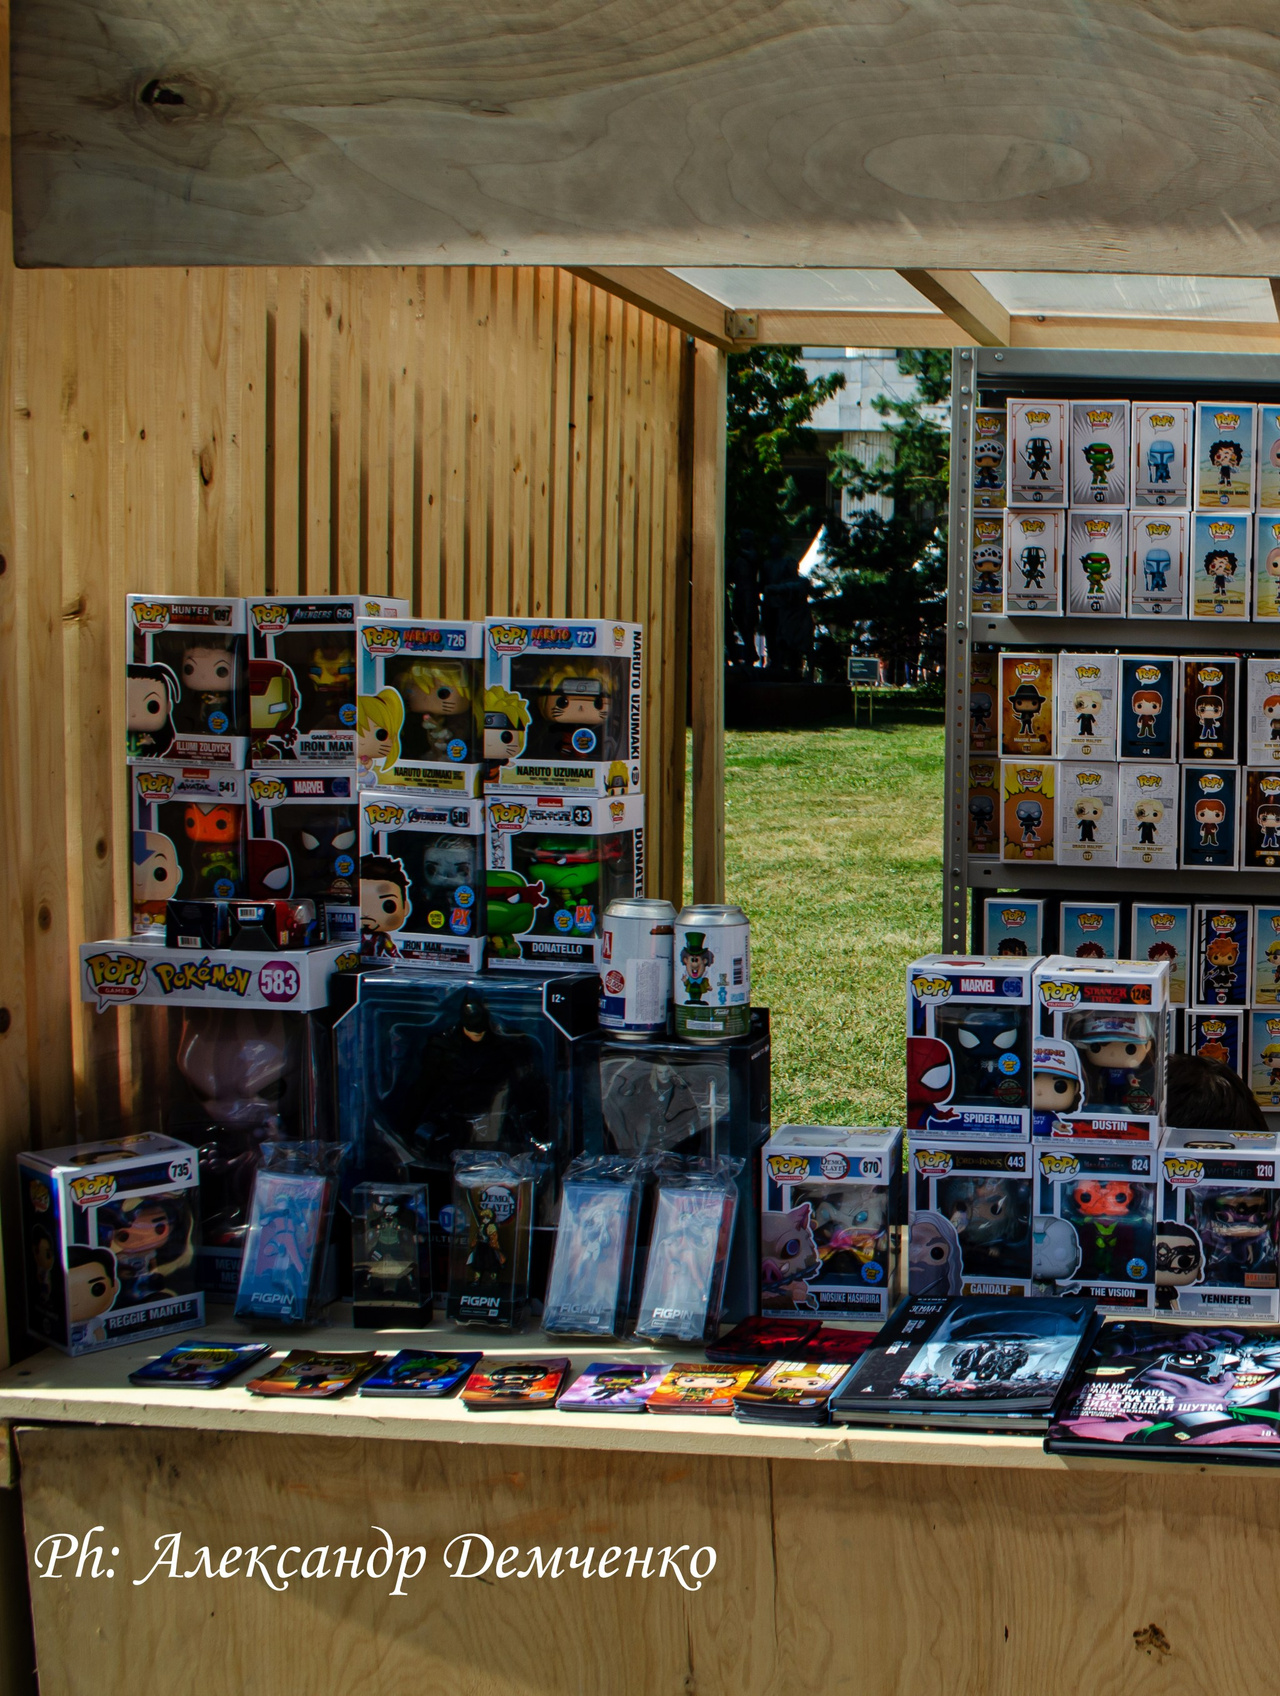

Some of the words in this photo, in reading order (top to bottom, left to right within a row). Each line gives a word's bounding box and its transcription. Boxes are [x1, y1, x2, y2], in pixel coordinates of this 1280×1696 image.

[132, 602, 167, 622] POP!
[172, 606, 209, 615] HUNTER
[251, 604, 288, 624] POP!
[337, 608, 352, 619] 626
[361, 626, 399, 647] POP!
[403, 630, 441, 644] NARUTO
[489, 625, 527, 645] POP!
[531, 627, 570, 640] NARUTO
[576, 630, 594, 644] 727
[447, 634, 464, 647] 726
[631, 631, 641, 689] NARUTO
[630, 692, 641, 760] UZUMAKI
[301, 742, 325, 751] IRON
[329, 742, 353, 751] MAN
[394, 767, 420, 776] NARUTO
[422, 768, 452, 778] UZUMAKI
[517, 766, 550, 776] NARUTO
[553, 768, 593, 778] UZUMAKI
[136, 774, 174, 792] POP!
[218, 782, 235, 792] 541
[294, 781, 324, 793] MARVEL
[250, 780, 286, 800] POP!
[364, 804, 404, 824] POP!
[490, 804, 525, 823] POP!
[574, 810, 591, 822] 33
[576, 906, 593, 923] PX
[403, 941, 421, 951] IRON
[423, 942, 442, 951] MAN
[532, 942, 583, 954] DONATELLO
[85, 954, 146, 986] POP!
[261, 969, 298, 995] 583
[911, 978, 952, 998] POP!
[961, 979, 994, 993] MARVEL
[1003, 980, 1020, 993] 956
[1039, 984, 1079, 1001] POP!
[1083, 988, 1127, 999] STRANGER
[1131, 988, 1150, 999] 1249
[963, 1113, 1020, 1124] SPIDER-MAN
[1092, 1120, 1128, 1131] DUSTIN
[914, 1151, 952, 1169] POP!
[1007, 1154, 1024, 1168] 443
[1039, 1156, 1079, 1175] POP!
[1132, 1159, 1149, 1172] 824
[171, 1165, 189, 1178] 735
[767, 1156, 808, 1178] POP!
[863, 1160, 879, 1174] 870
[1164, 1161, 1203, 1178] POP!
[1256, 1165, 1273, 1177] 1210
[70, 1174, 115, 1199] POP!
[970, 1284, 1011, 1295] GANDALF
[1090, 1288, 1108, 1297] THE
[1110, 1288, 1136, 1298] VISION
[251, 1292, 294, 1304] FIGPIN
[461, 1296, 500, 1308] FIGPIN
[820, 1293, 846, 1303] INOSUKE
[848, 1293, 880, 1304] HASHIBIRA
[1201, 1294, 1251, 1305] YENNEFER
[109, 1311, 147, 1330] REGGIE
[150, 1302, 191, 1319] MANTLE
[653, 1308, 693, 1319] FIGPIN
[1076, 1400, 1174, 1411] УБИЙСТВЕННАЯ
